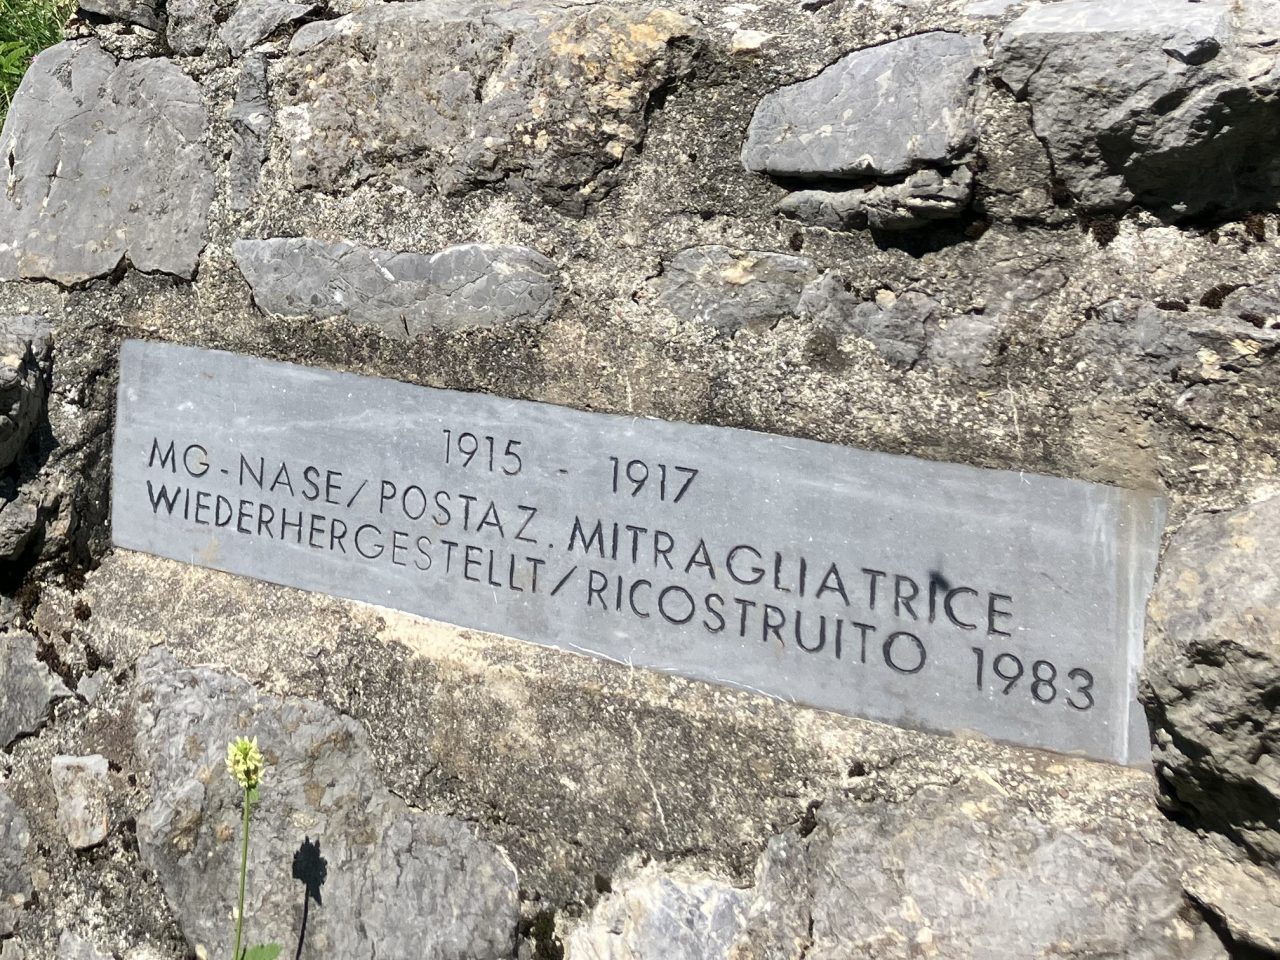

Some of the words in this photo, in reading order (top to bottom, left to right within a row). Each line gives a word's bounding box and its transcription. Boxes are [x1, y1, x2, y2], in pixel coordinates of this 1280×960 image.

[443, 429, 521, 475] 1915
[609, 456, 698, 502] 1917
[568, 515, 1013, 637] MITRAGLIATRICE
[972, 646, 1095, 711] 1983
